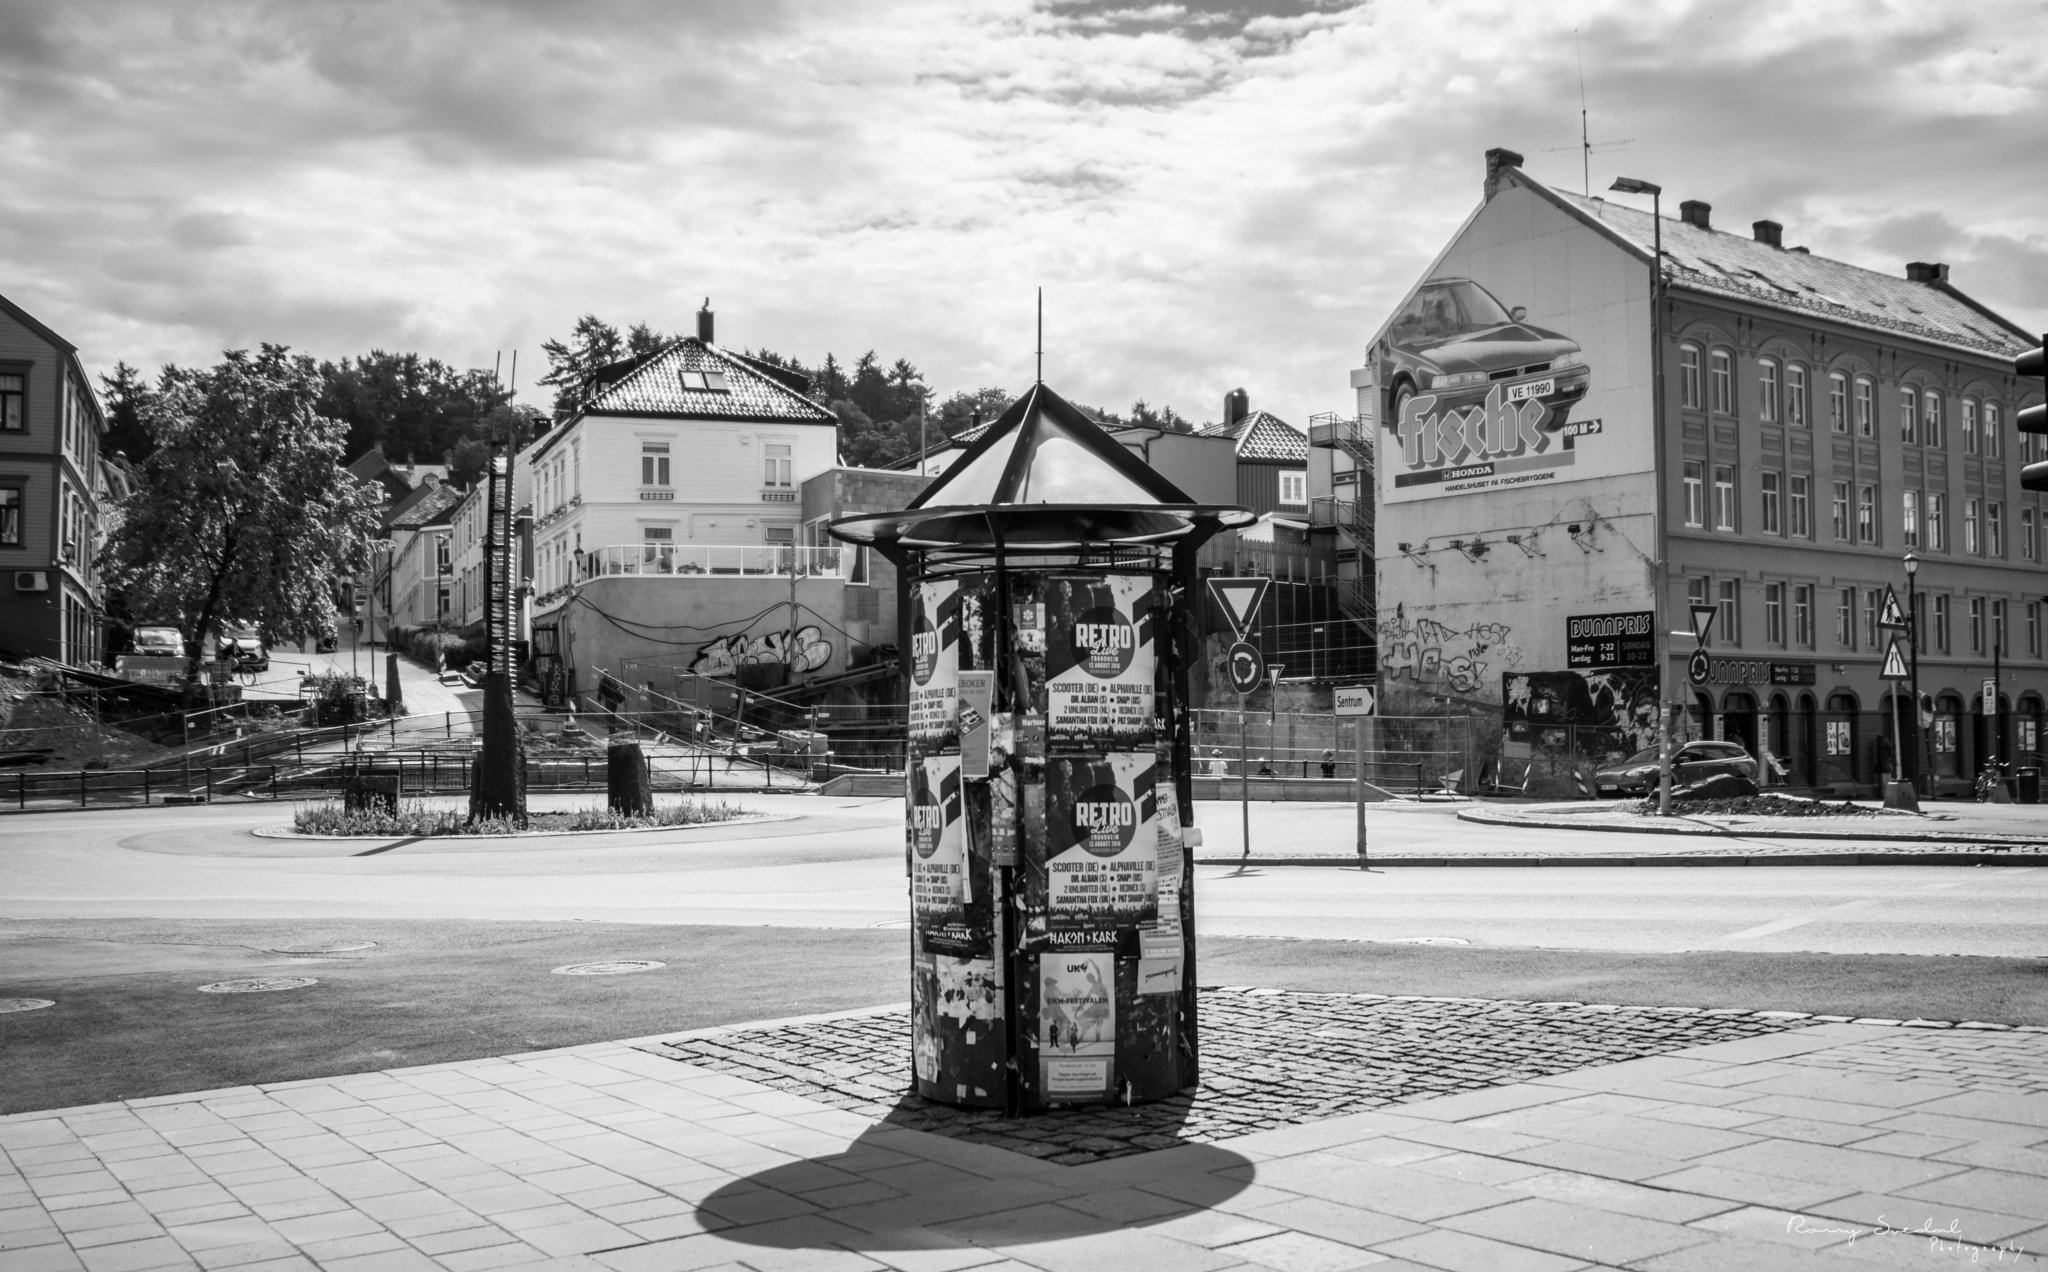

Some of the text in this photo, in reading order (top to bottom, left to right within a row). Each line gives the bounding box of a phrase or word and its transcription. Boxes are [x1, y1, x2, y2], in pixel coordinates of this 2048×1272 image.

[1512, 382, 1551, 398] VE 11990
[1398, 383, 1547, 467] fische
[1564, 424, 1588, 436] 100 M
[1451, 466, 1492, 478] HONDA
[1445, 472, 1555, 492] HANDELSHUSET PÅ FISCHEBRYGGENE
[1570, 614, 1650, 638] BUNNPRIS
[1075, 623, 1131, 649] RETRO
[1090, 637, 1119, 656] Live
[1600, 642, 1614, 651] 7-22
[1600, 653, 1615, 661] 9-21
[1709, 661, 1771, 683] UNNPRIS
[1052, 683, 1084, 693] SCOOTER
[1085, 683, 1099, 694] (DE)
[1110, 684, 1142, 694] ALPHAVILLE
[1081, 695, 1098, 704] ALBAN
[1099, 695, 1107, 704] (S)
[1337, 697, 1363, 708] Sentrum
[1069, 705, 1098, 714] UNLIMITED
[1099, 705, 1110, 714] (NL)
[1119, 706, 1136, 714] REDNEX
[1056, 716, 1087, 724] SAMANTHA
[1088, 716, 1098, 724] FOX
[1118, 717, 1126, 725] PAT
[1127, 717, 1141, 725] SHARP
[913, 805, 939, 829] RETRO
[1076, 802, 1132, 826] RETRO
[1091, 816, 1119, 834] Live
[1052, 862, 1084, 873] SCOOTER
[1085, 862, 1099, 873] (DE)
[1110, 861, 1144, 872] ALPHAVILLE
[1081, 874, 1098, 883] ALBAN
[1099, 874, 1107, 883] (S)
[1068, 885, 1098, 893] UNLIMITED
[1099, 885, 1110, 893] (NL)
[1119, 884, 1138, 892] REDNEX
[1056, 896, 1087, 904] SAMANTHA
[1088, 896, 1098, 904] FOX
[1118, 894, 1127, 903] PAT
[1128, 894, 1143, 903] SHARP
[1047, 997, 1108, 1005] UKM-FESTIVALEN
